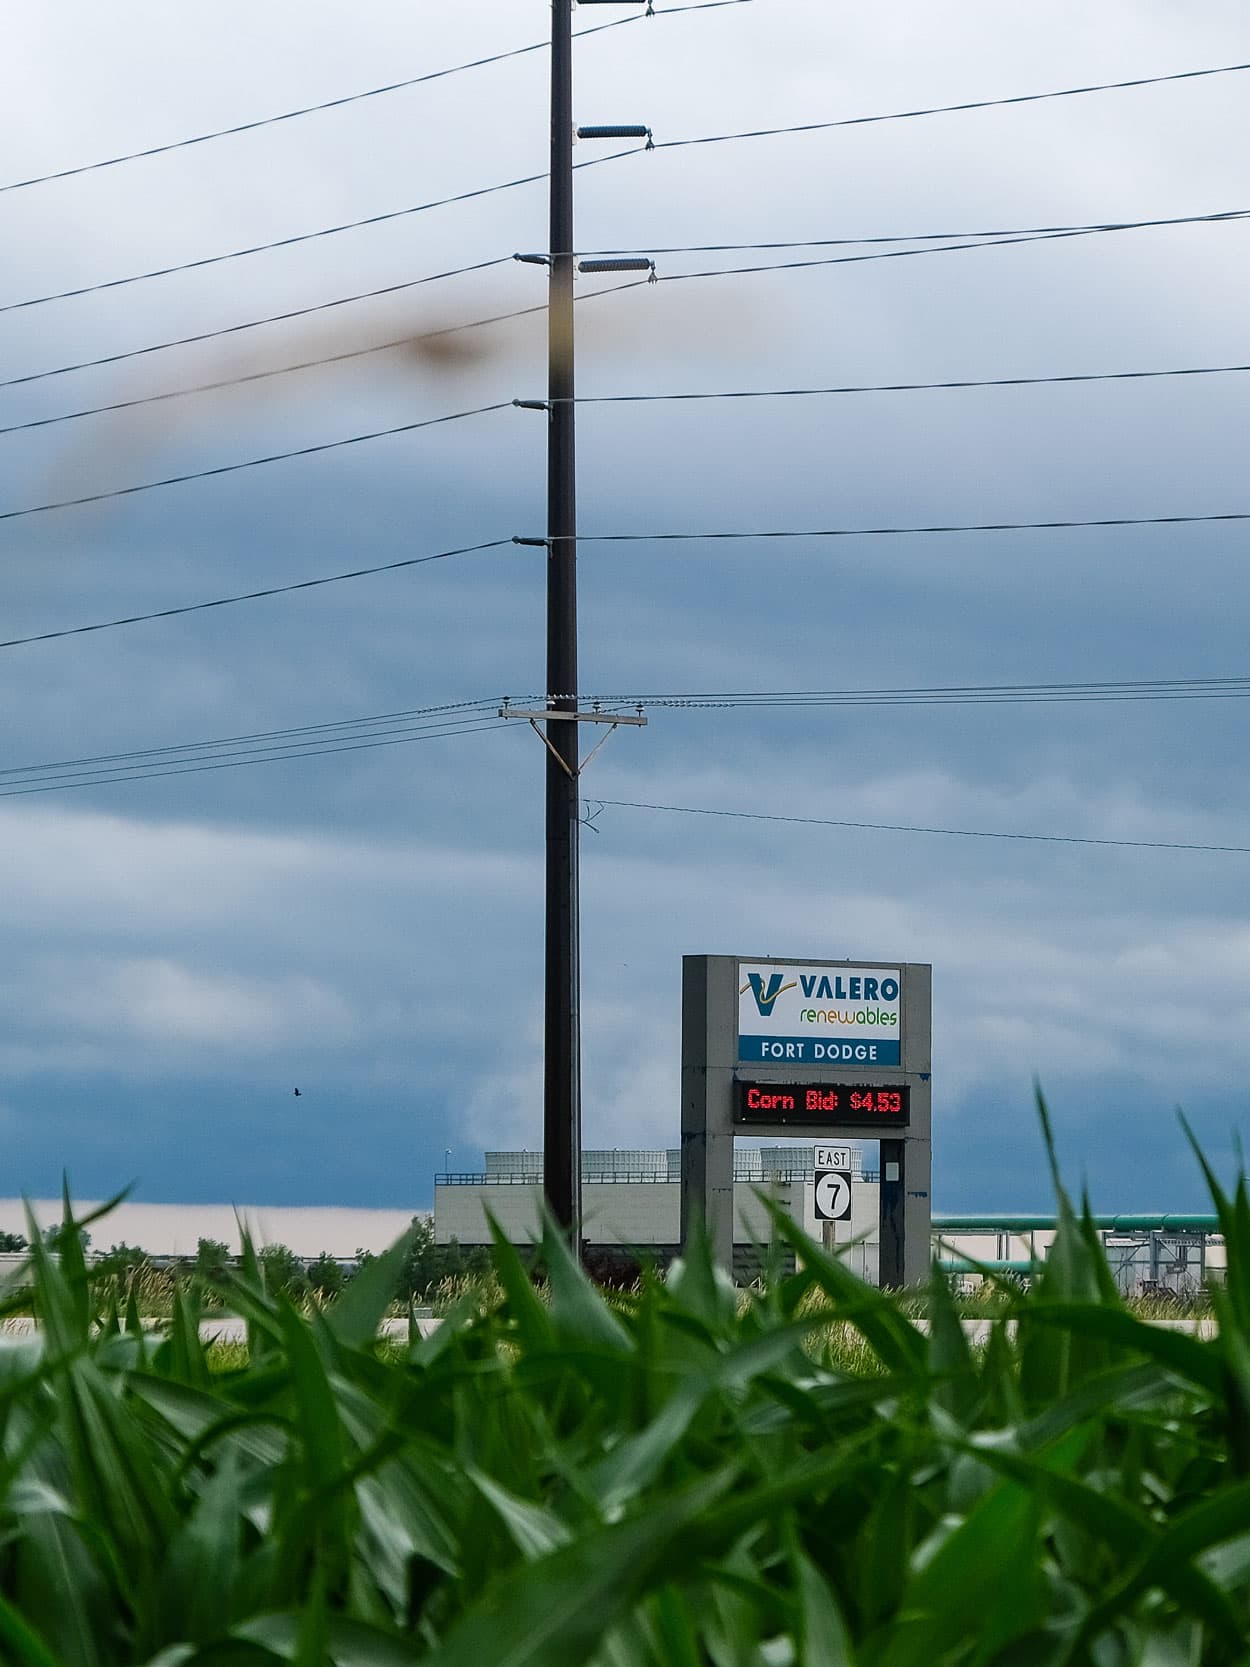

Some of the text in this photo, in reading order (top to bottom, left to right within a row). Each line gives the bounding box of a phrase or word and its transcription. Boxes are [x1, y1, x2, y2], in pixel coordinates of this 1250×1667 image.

[800, 974, 899, 1001] VALERO
[800, 1006, 897, 1026] renewables
[761, 1042, 877, 1060] FORT DODGE
[747, 1088, 794, 1110] Corn
[850, 1091, 901, 1113] $4.53
[818, 1150, 846, 1167] EAST
[826, 1184, 841, 1210] 7
